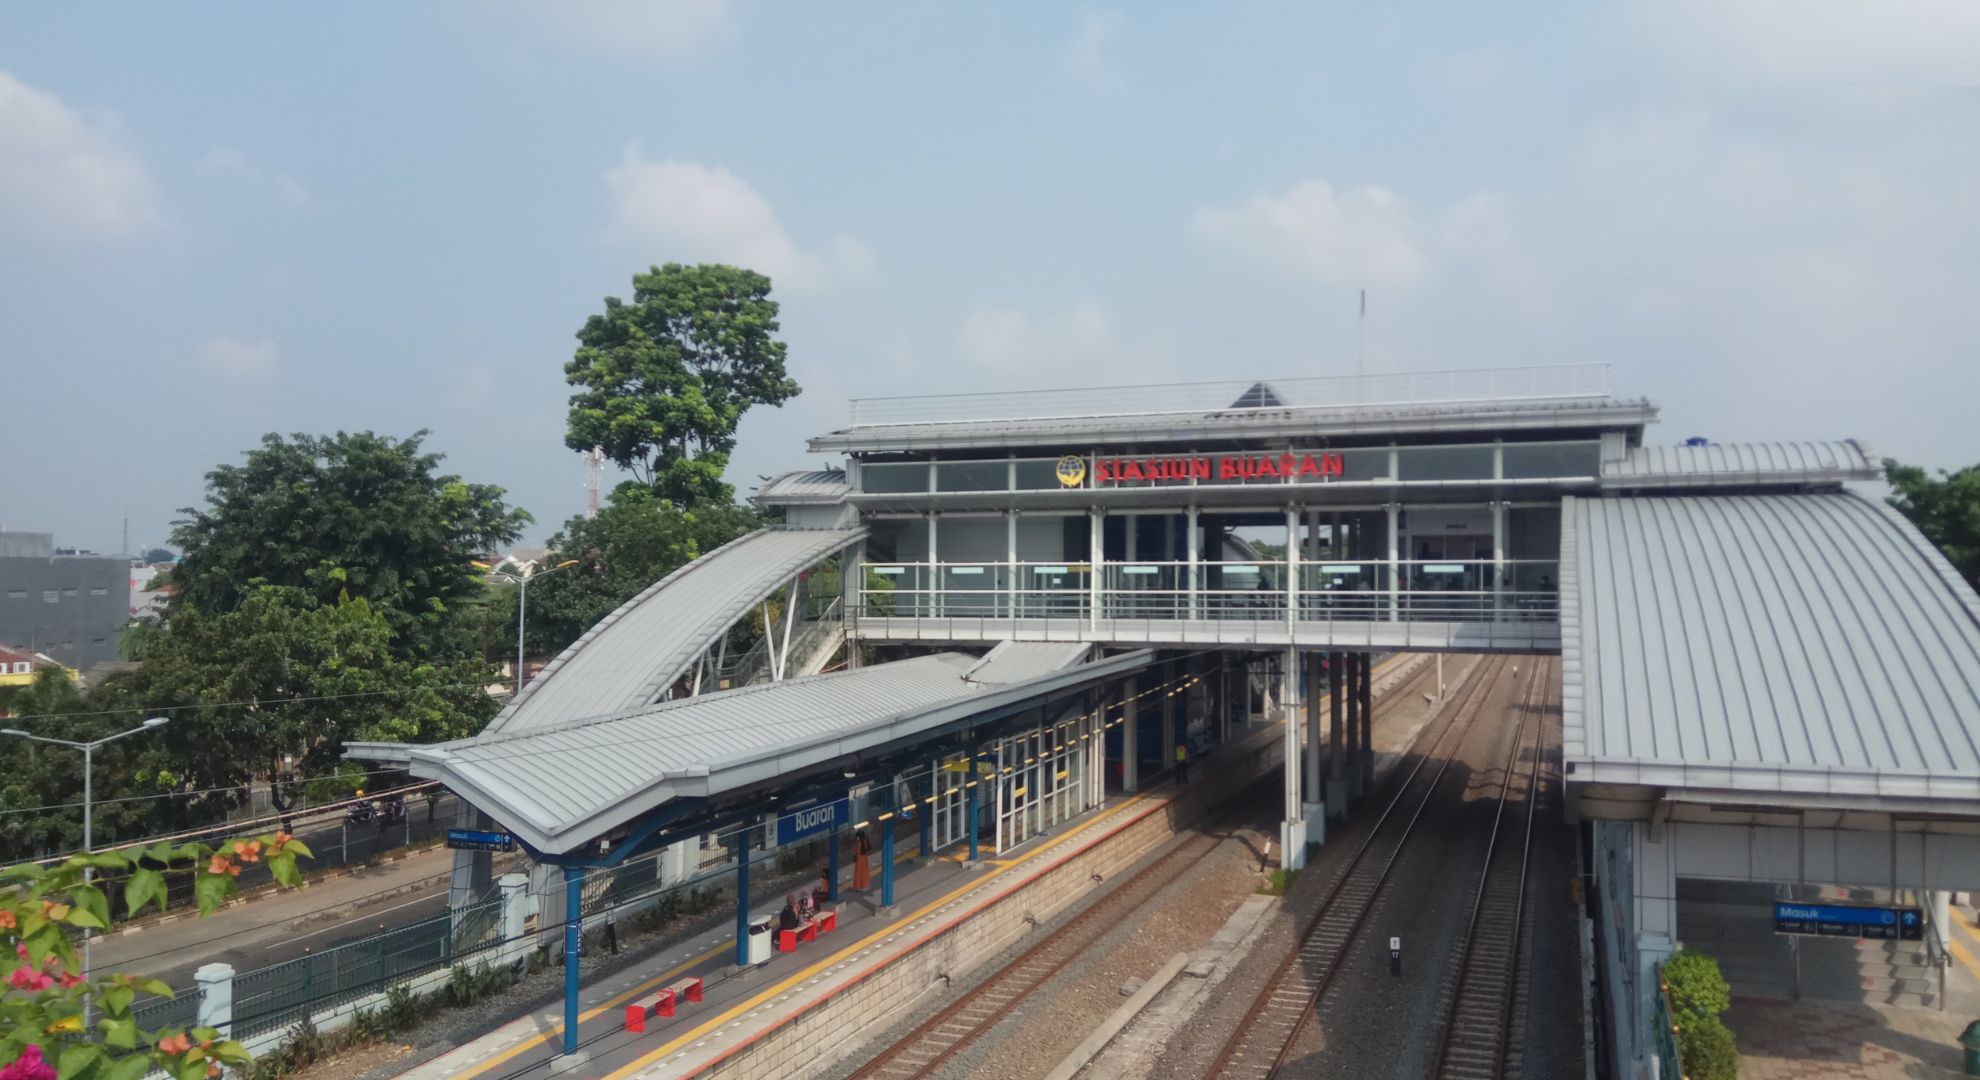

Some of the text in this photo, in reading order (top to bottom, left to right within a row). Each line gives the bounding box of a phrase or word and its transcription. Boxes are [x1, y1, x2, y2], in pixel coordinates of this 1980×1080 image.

[1095, 451, 1343, 482] STASIUN BUARAN
[795, 804, 835, 832] Buaran
[1780, 906, 1821, 919] Masuk
